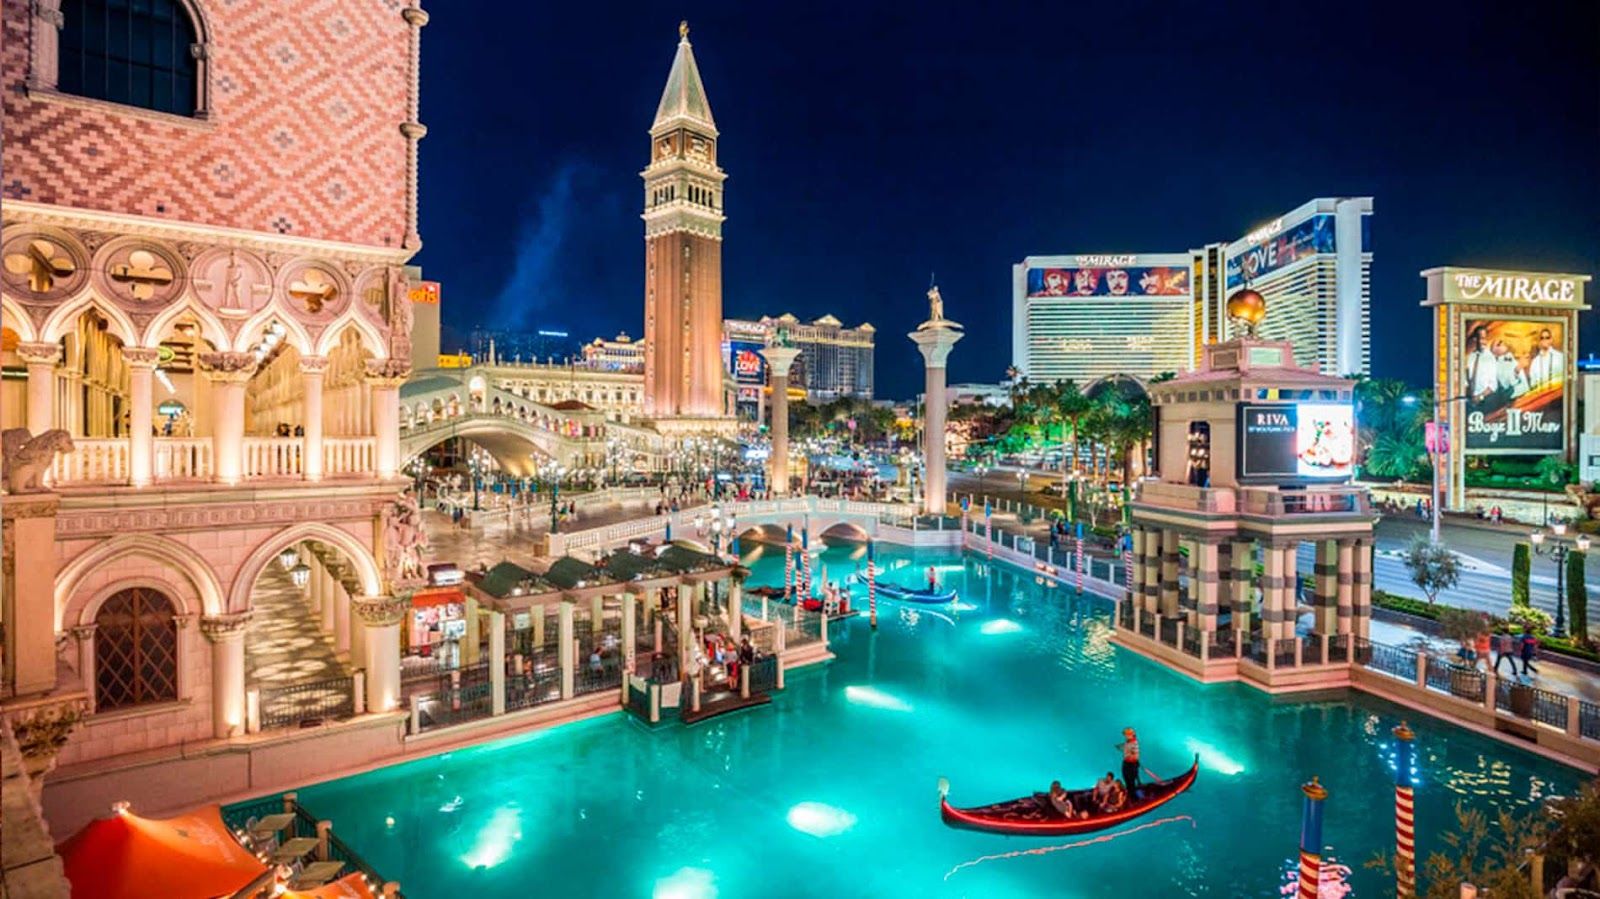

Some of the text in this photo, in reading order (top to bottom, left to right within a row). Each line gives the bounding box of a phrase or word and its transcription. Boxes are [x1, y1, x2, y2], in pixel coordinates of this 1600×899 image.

[1243, 241, 1278, 274] OVE
[1455, 274, 1575, 303] THE MIRAGE
[1257, 413, 1289, 426] RIVA
[1522, 411, 1560, 433] Men
